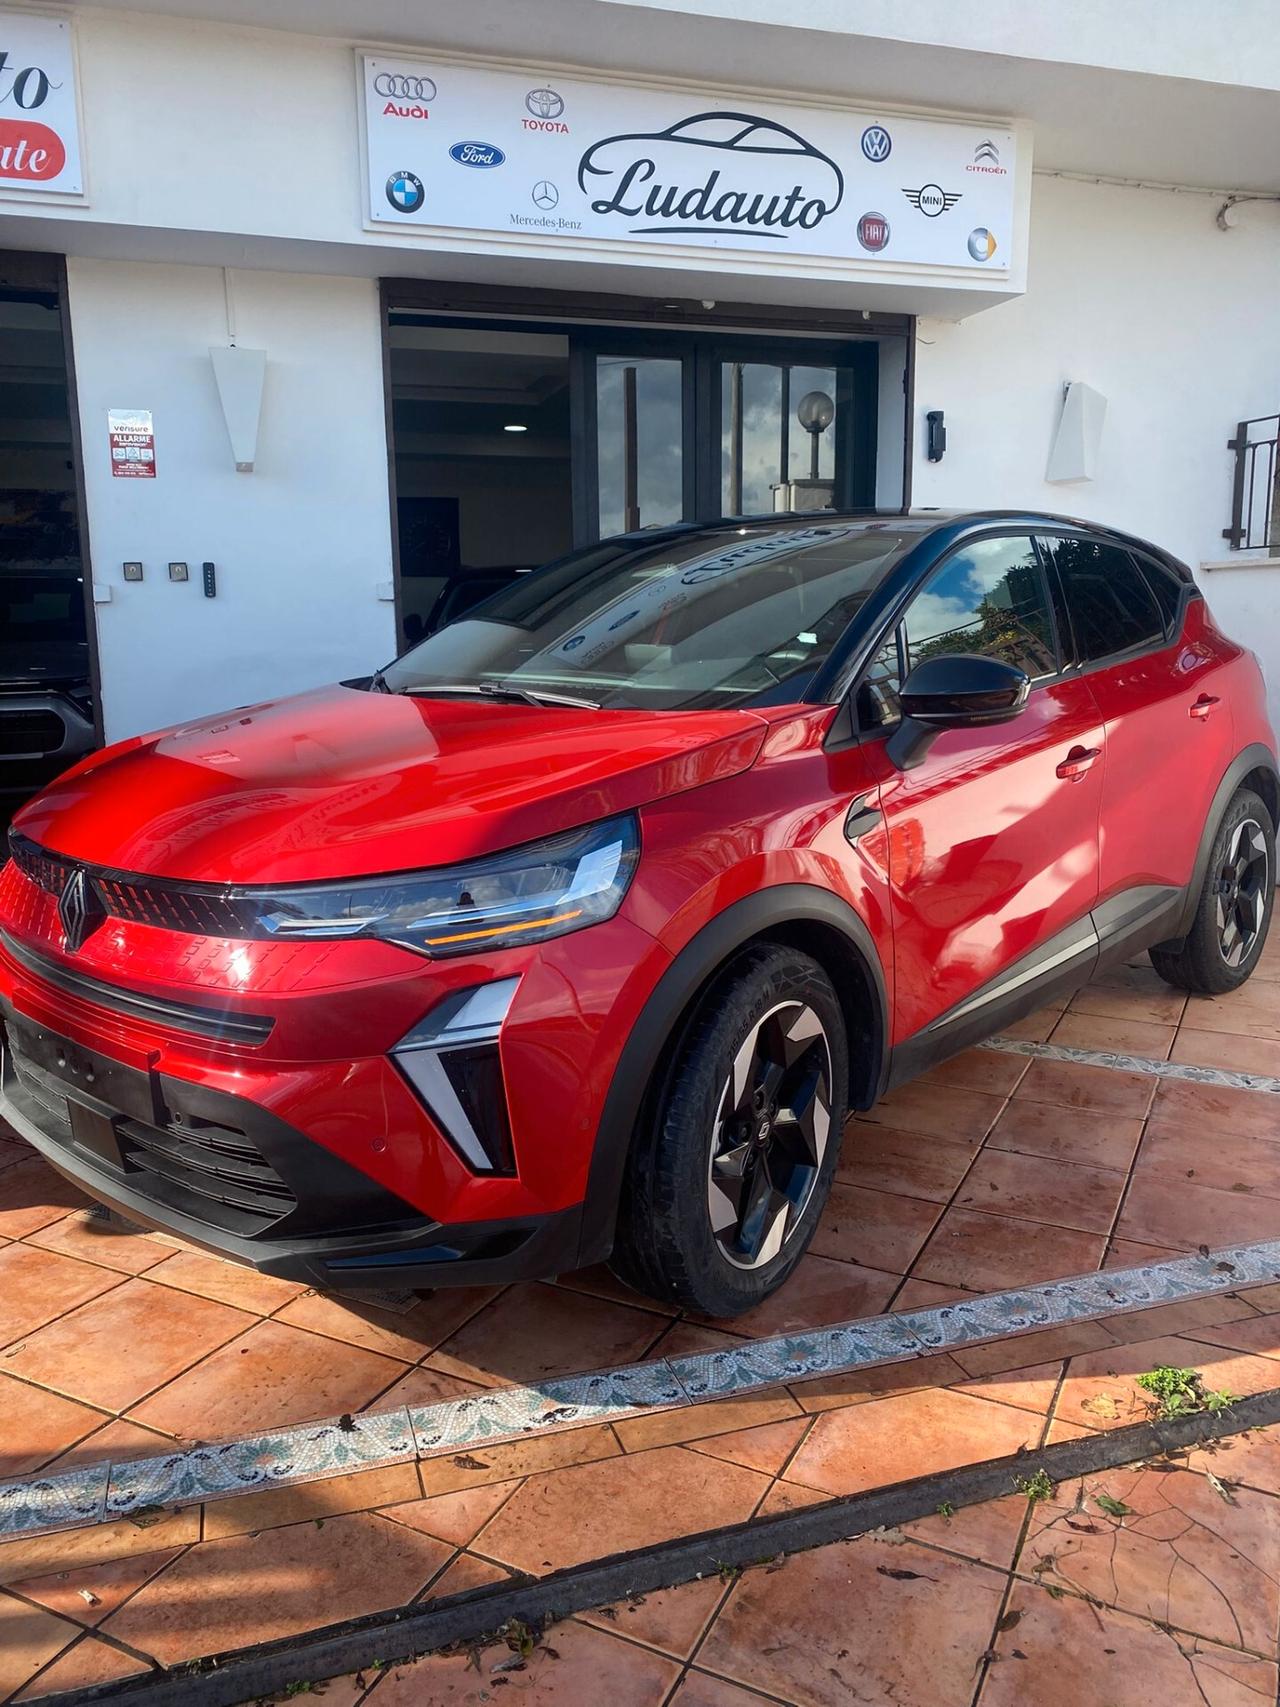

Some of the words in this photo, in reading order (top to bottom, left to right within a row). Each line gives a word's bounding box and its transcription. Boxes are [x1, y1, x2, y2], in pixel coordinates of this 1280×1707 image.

[383, 102, 429, 119] Audi
[521, 119, 569, 133] TOYOTA
[460, 144, 494, 164] Ford
[389, 171, 421, 187] BMW
[591, 158, 826, 230] Ludauto
[922, 195, 943, 206] MINI
[509, 213, 583, 230] Mercedes-Benz
[865, 223, 884, 241] FIAT
[113, 435, 151, 443] ALLARME
